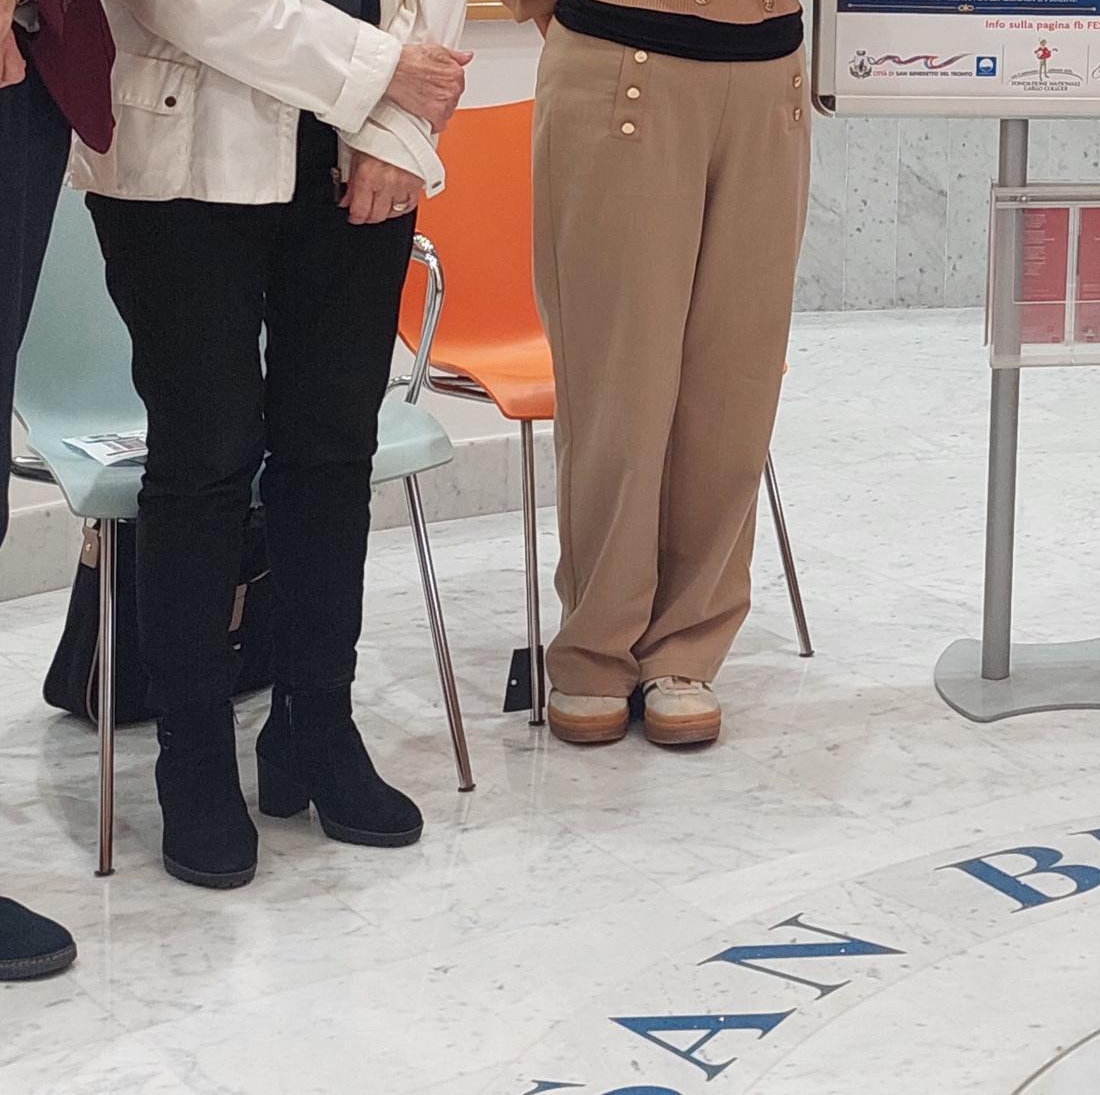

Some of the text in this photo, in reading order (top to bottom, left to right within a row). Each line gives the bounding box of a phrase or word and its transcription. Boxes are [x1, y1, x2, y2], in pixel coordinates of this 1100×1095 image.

[985, 20, 1006, 29] Info
[1009, 21, 1033, 29] sulla
[1036, 22, 1070, 31] pagina
[1074, 21, 1083, 29] fb
